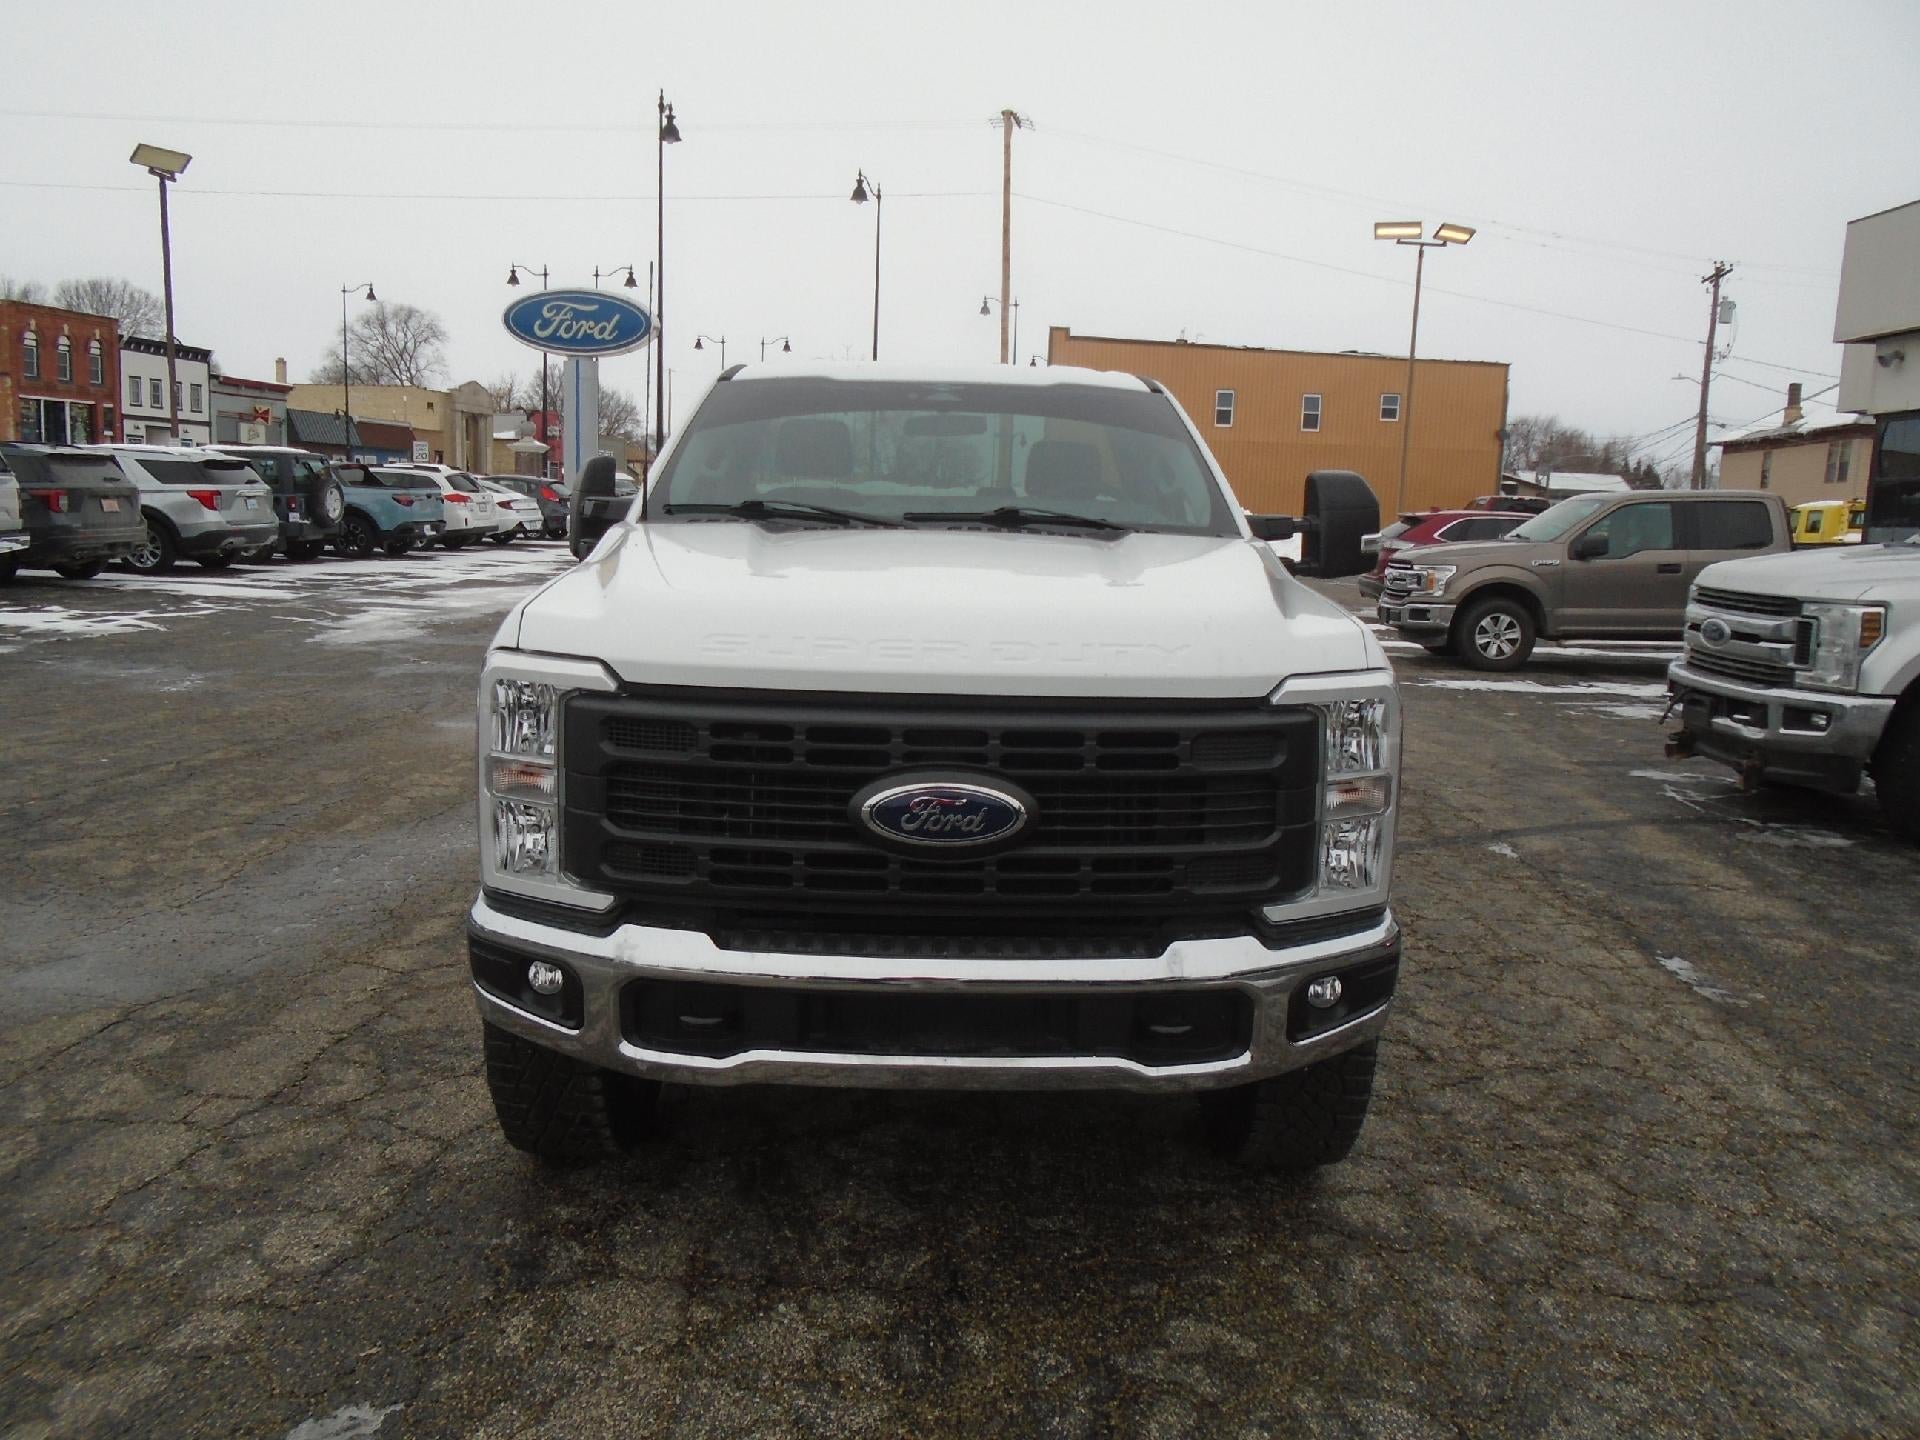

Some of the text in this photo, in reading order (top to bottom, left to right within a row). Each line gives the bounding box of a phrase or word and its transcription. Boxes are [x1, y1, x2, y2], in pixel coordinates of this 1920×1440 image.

[533, 301, 620, 341] Ford
[415, 452, 428, 460] 20
[698, 632, 1191, 667] SUPER DUTY
[900, 796, 988, 831] Ford
